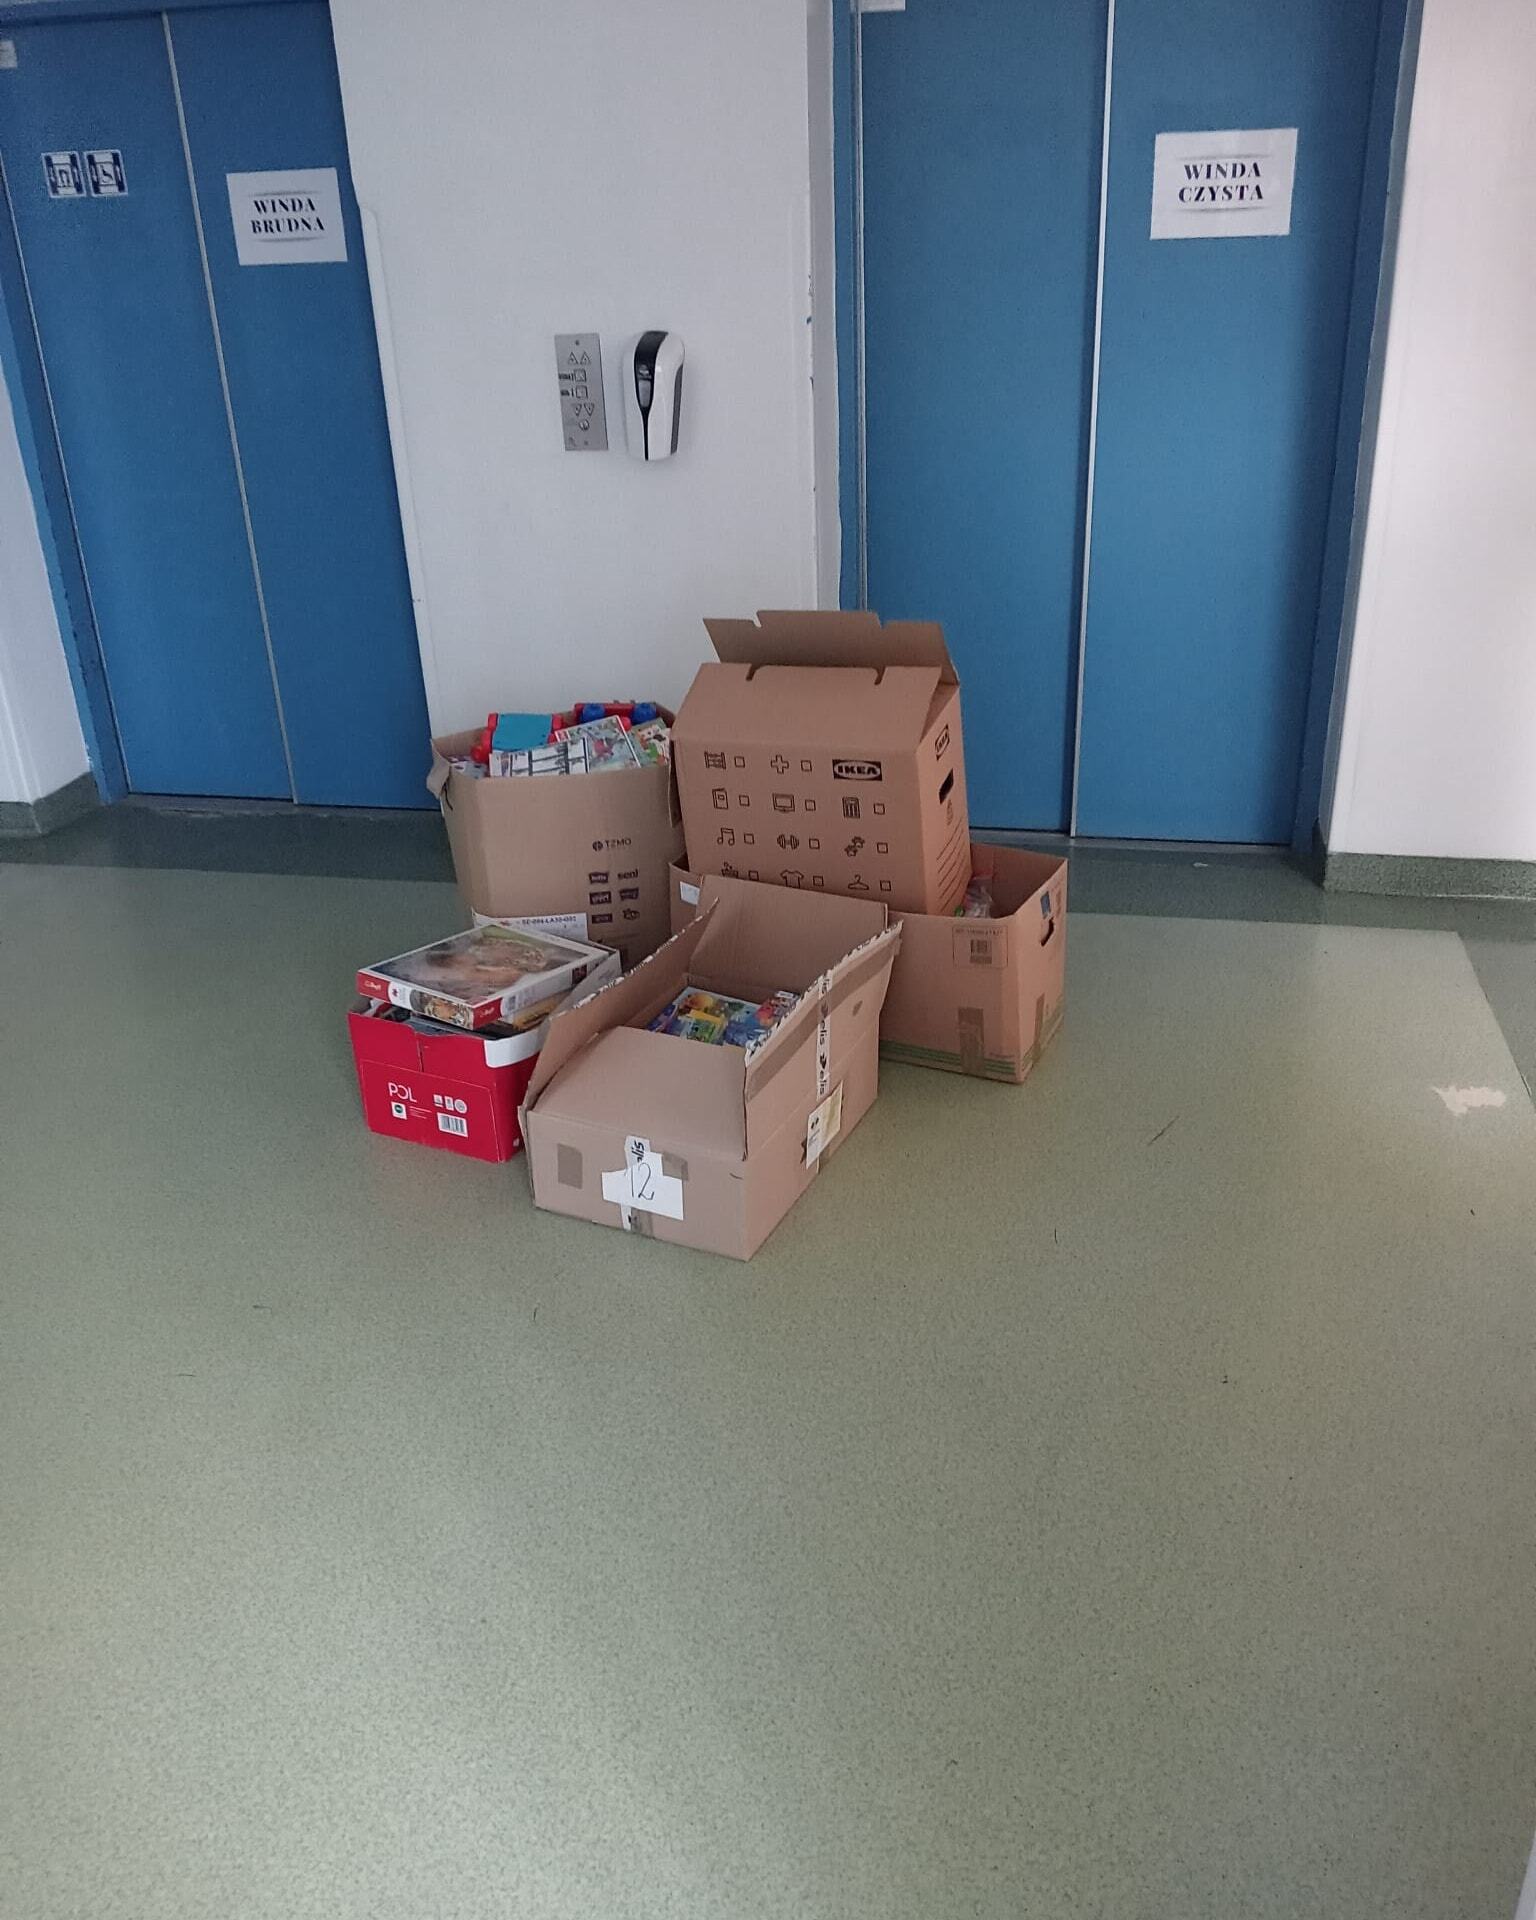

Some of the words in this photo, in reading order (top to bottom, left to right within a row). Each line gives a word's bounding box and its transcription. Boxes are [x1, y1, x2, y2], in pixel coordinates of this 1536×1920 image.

[1184, 162, 1261, 180] WINDA
[1178, 184, 1263, 203] CZYSTA
[253, 198, 315, 214] WINDA
[251, 217, 325, 234] BRUDNA
[837, 765, 879, 775] IKEA
[624, 1162, 655, 1201] 12
